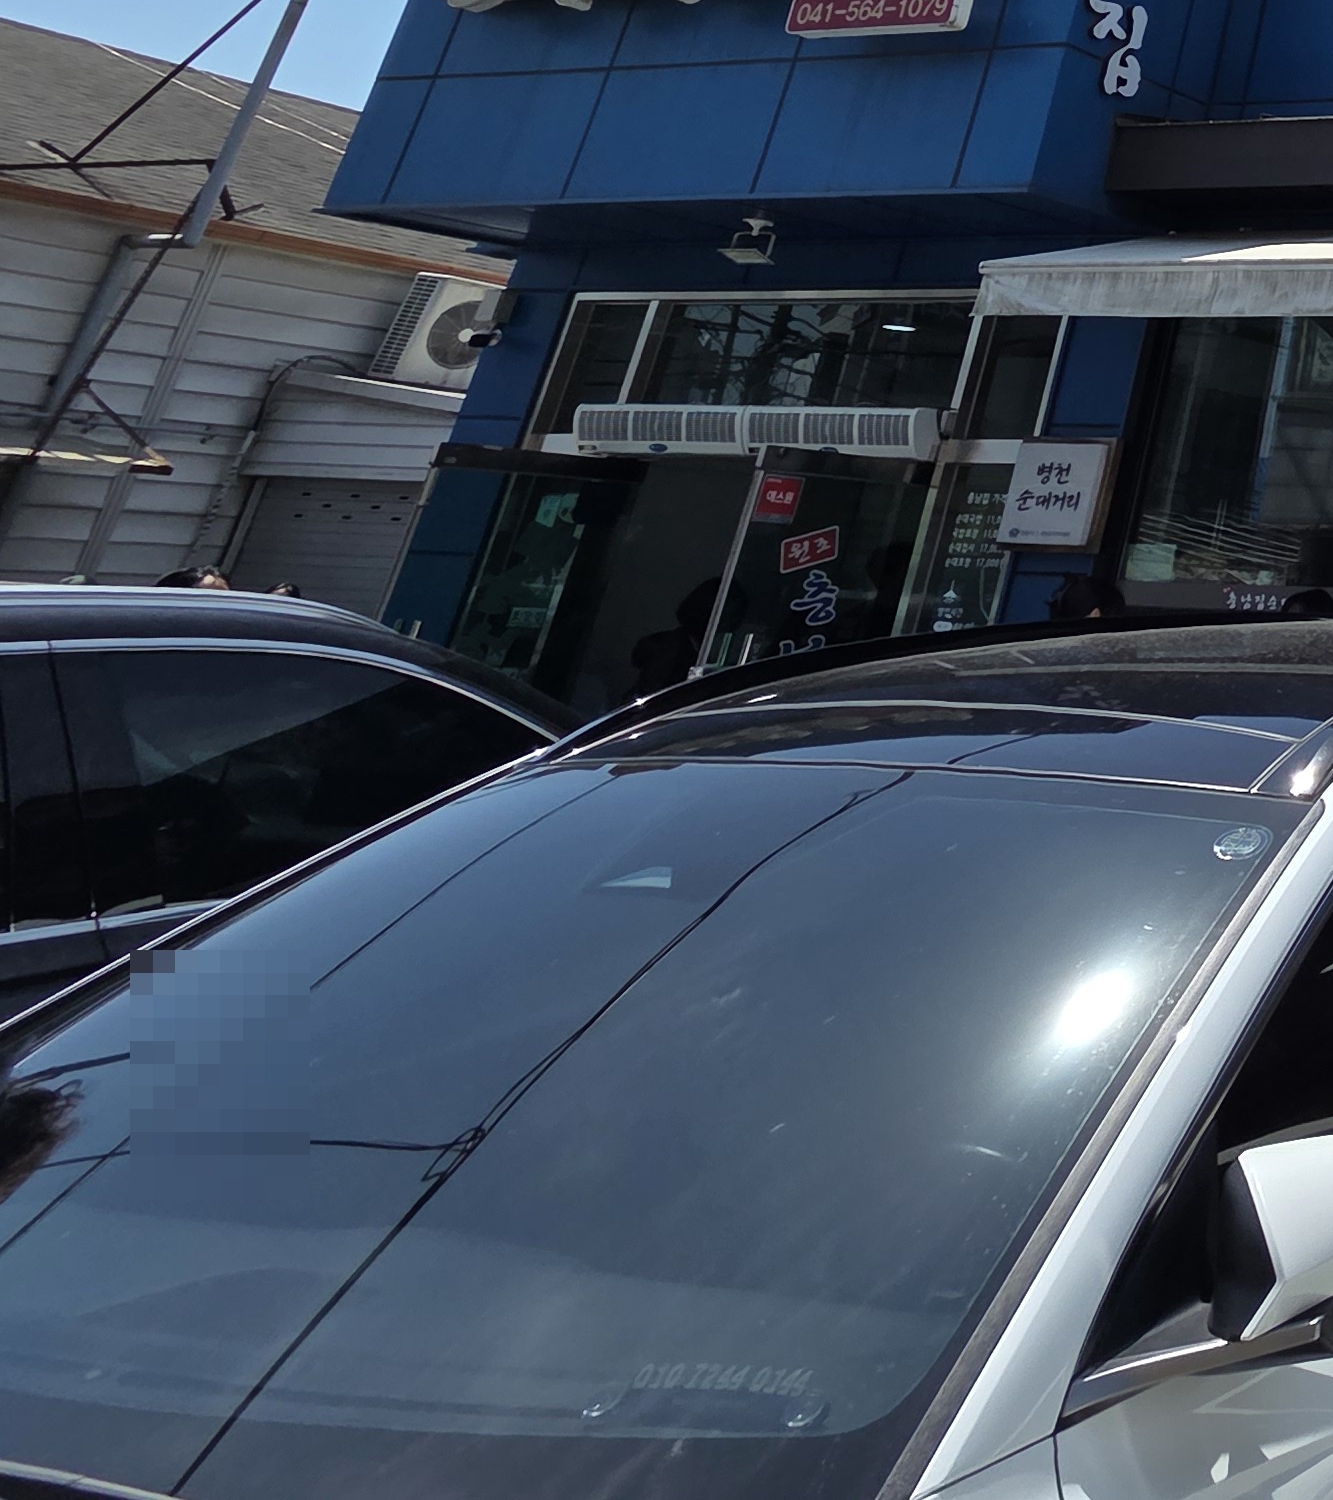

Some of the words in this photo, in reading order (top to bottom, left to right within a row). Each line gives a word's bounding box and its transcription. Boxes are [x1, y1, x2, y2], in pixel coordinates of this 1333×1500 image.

[1036, 461, 1072, 485] 병천
[1015, 488, 1081, 512] 순대거리
[788, 536, 831, 564] 원조
